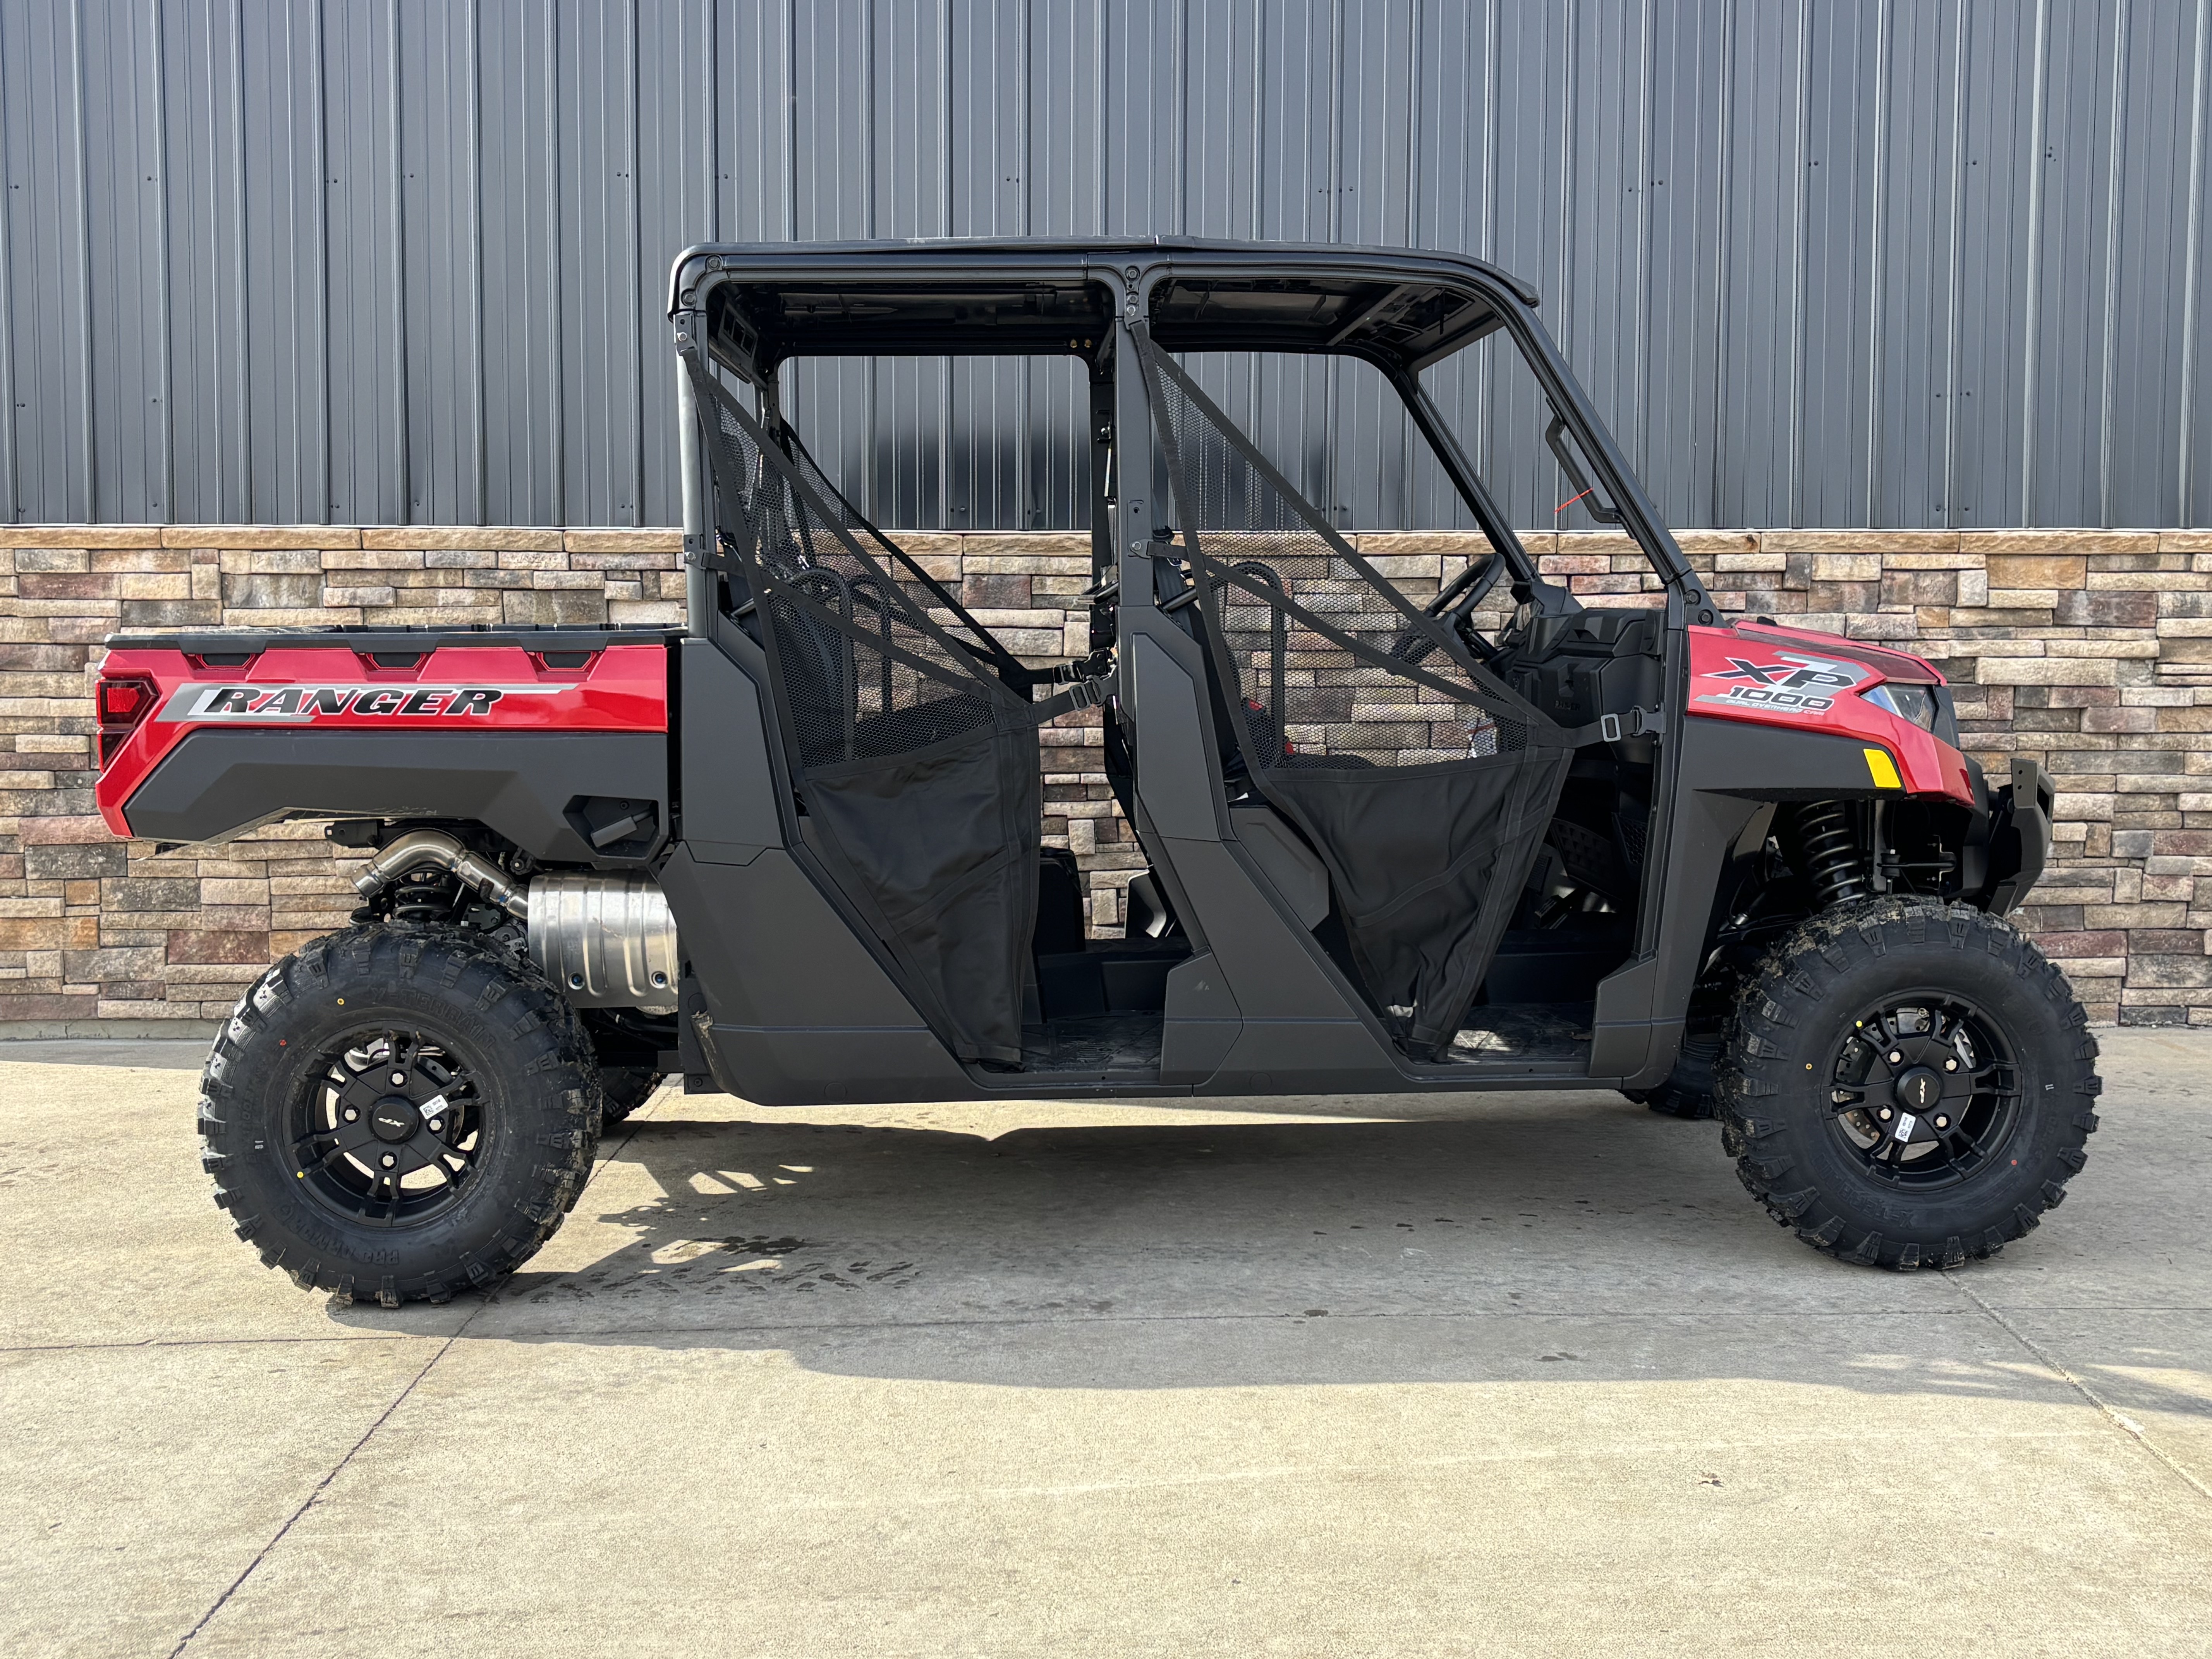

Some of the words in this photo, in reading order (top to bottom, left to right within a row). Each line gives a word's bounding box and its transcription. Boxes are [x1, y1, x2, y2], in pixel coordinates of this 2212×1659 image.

[1700, 657, 1856, 689] XP
[205, 687, 503, 715] RANGER
[1730, 685, 1834, 711] 1000
[1752, 703, 1803, 713] OVERHEAD
[378, 1117, 405, 1127] XP
